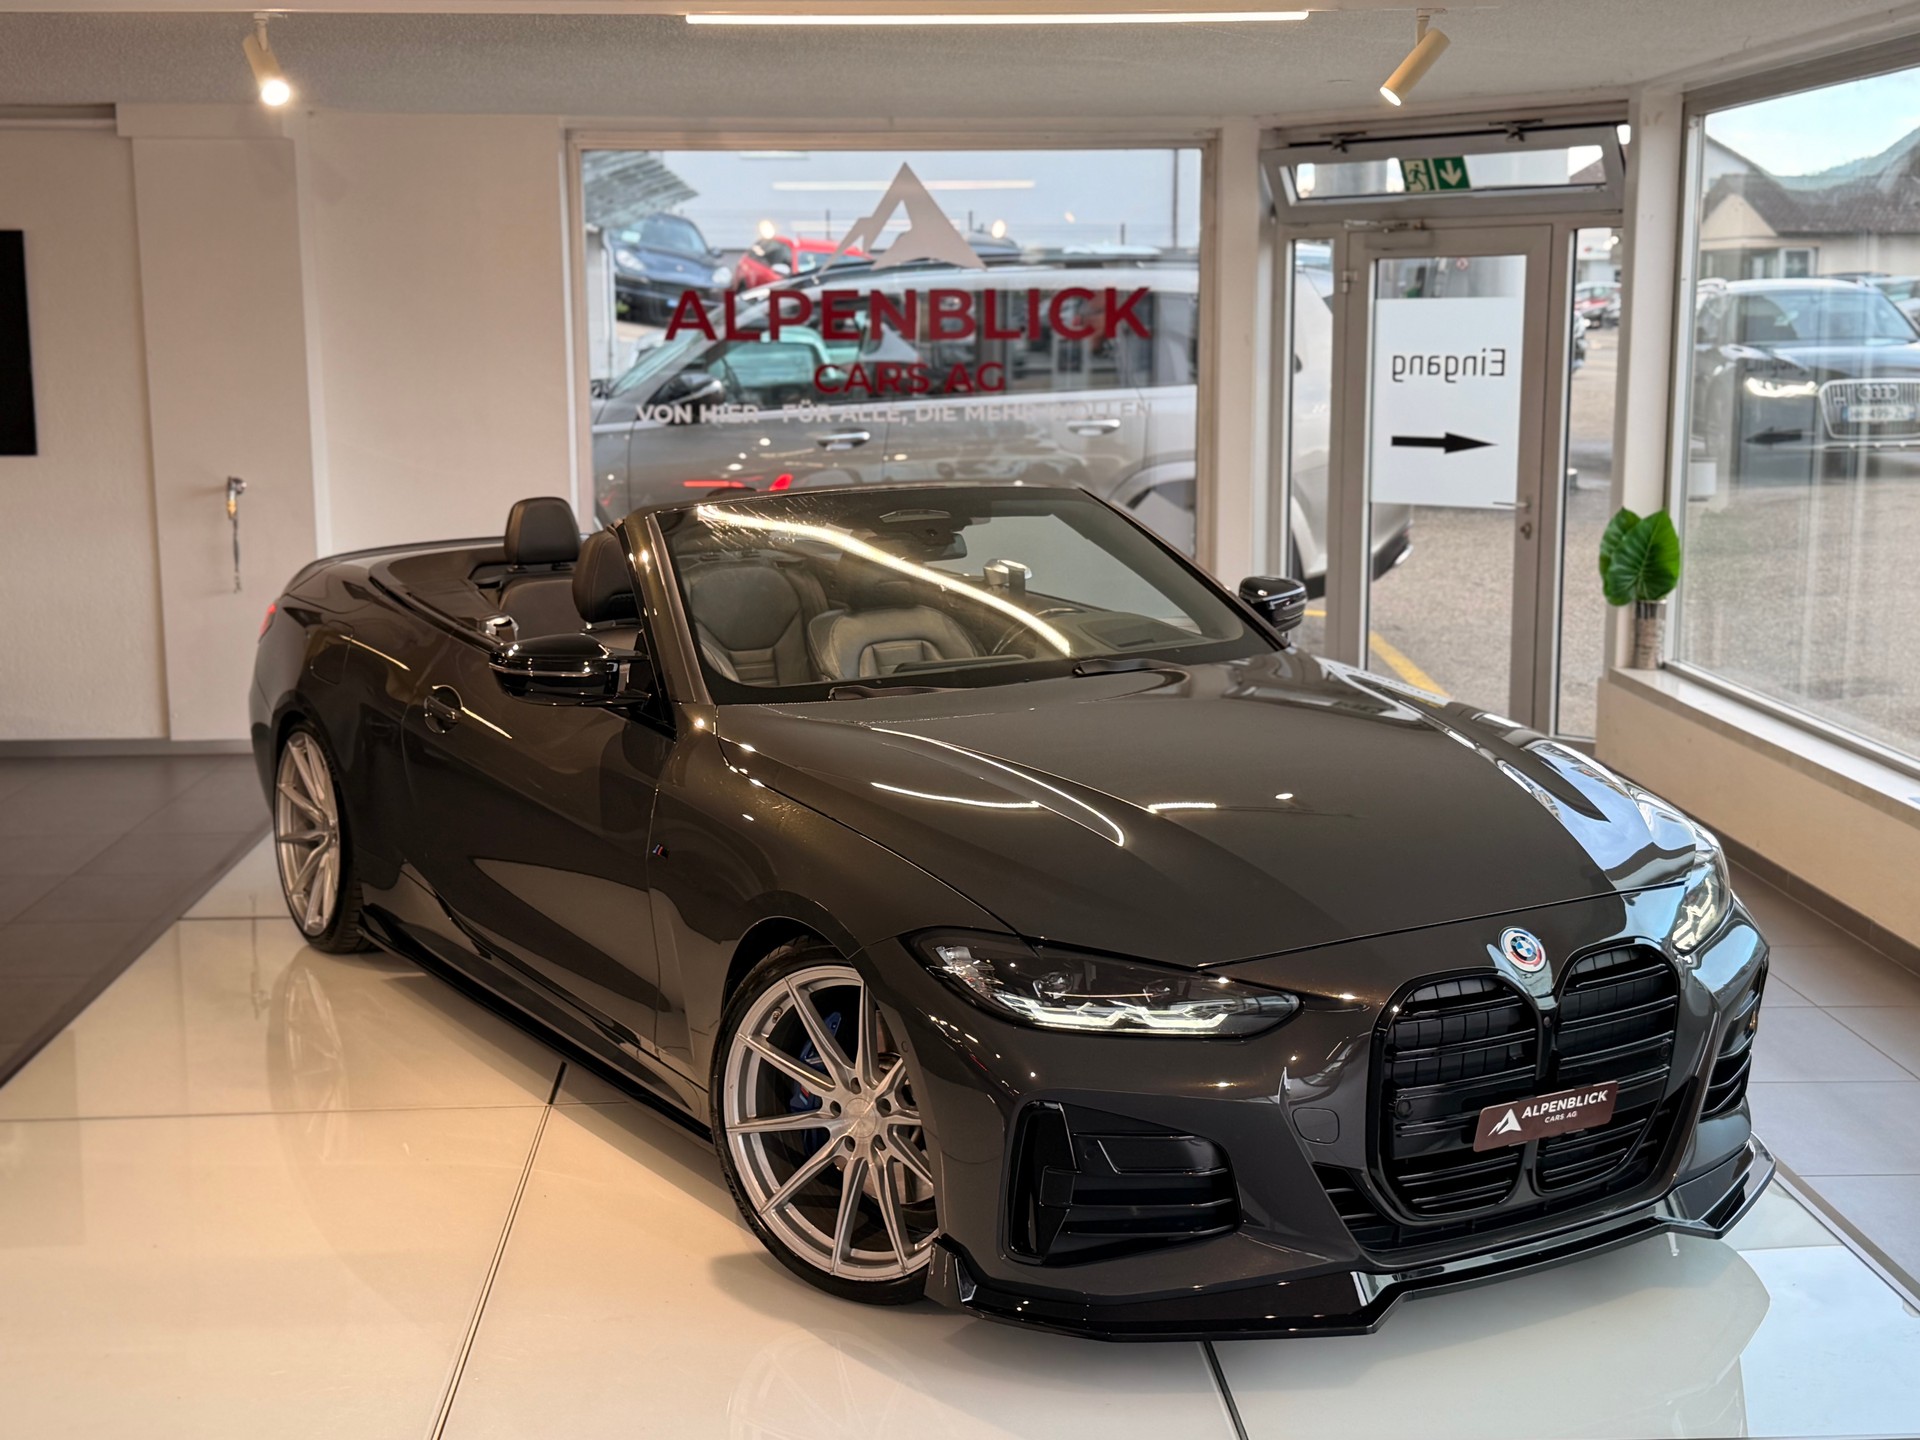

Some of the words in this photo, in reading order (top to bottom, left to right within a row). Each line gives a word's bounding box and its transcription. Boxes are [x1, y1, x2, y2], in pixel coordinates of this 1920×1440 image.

[665, 287, 1151, 341] ALPENBLICK
[813, 362, 931, 395] CARS
[944, 361, 1006, 394] AG
[636, 404, 692, 424] VON
[701, 404, 759, 424] HIER
[783, 399, 832, 423] FÜR
[839, 403, 908, 425] ALLE,
[915, 404, 957, 422] DIE
[1521, 1090, 1608, 1118] ALPENBLICK
[1544, 1113, 1564, 1123] CARS
[1566, 1110, 1577, 1118] AG
